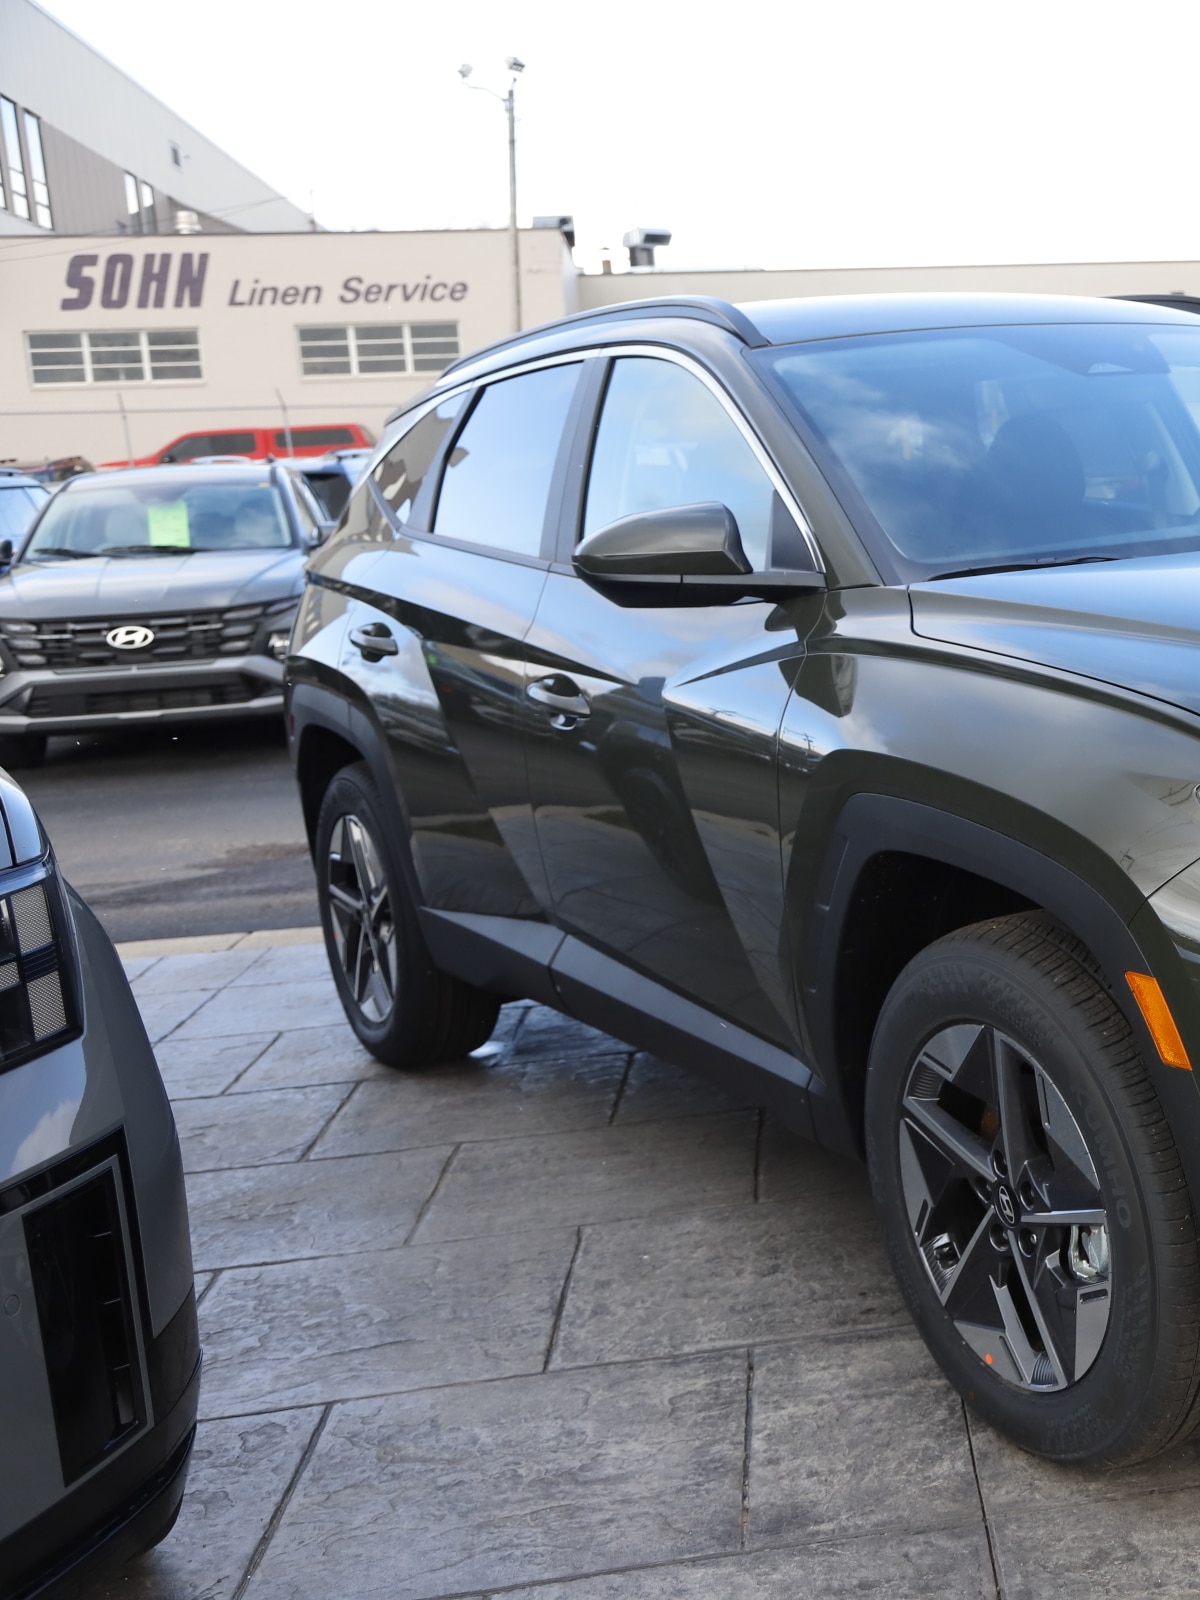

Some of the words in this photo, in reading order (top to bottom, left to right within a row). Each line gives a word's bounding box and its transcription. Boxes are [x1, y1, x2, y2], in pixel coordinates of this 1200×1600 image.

[61, 253, 209, 311] SOHN
[228, 279, 322, 306] Linen
[339, 275, 468, 303] Service
[1070, 1081, 1132, 1229] KUMHO
